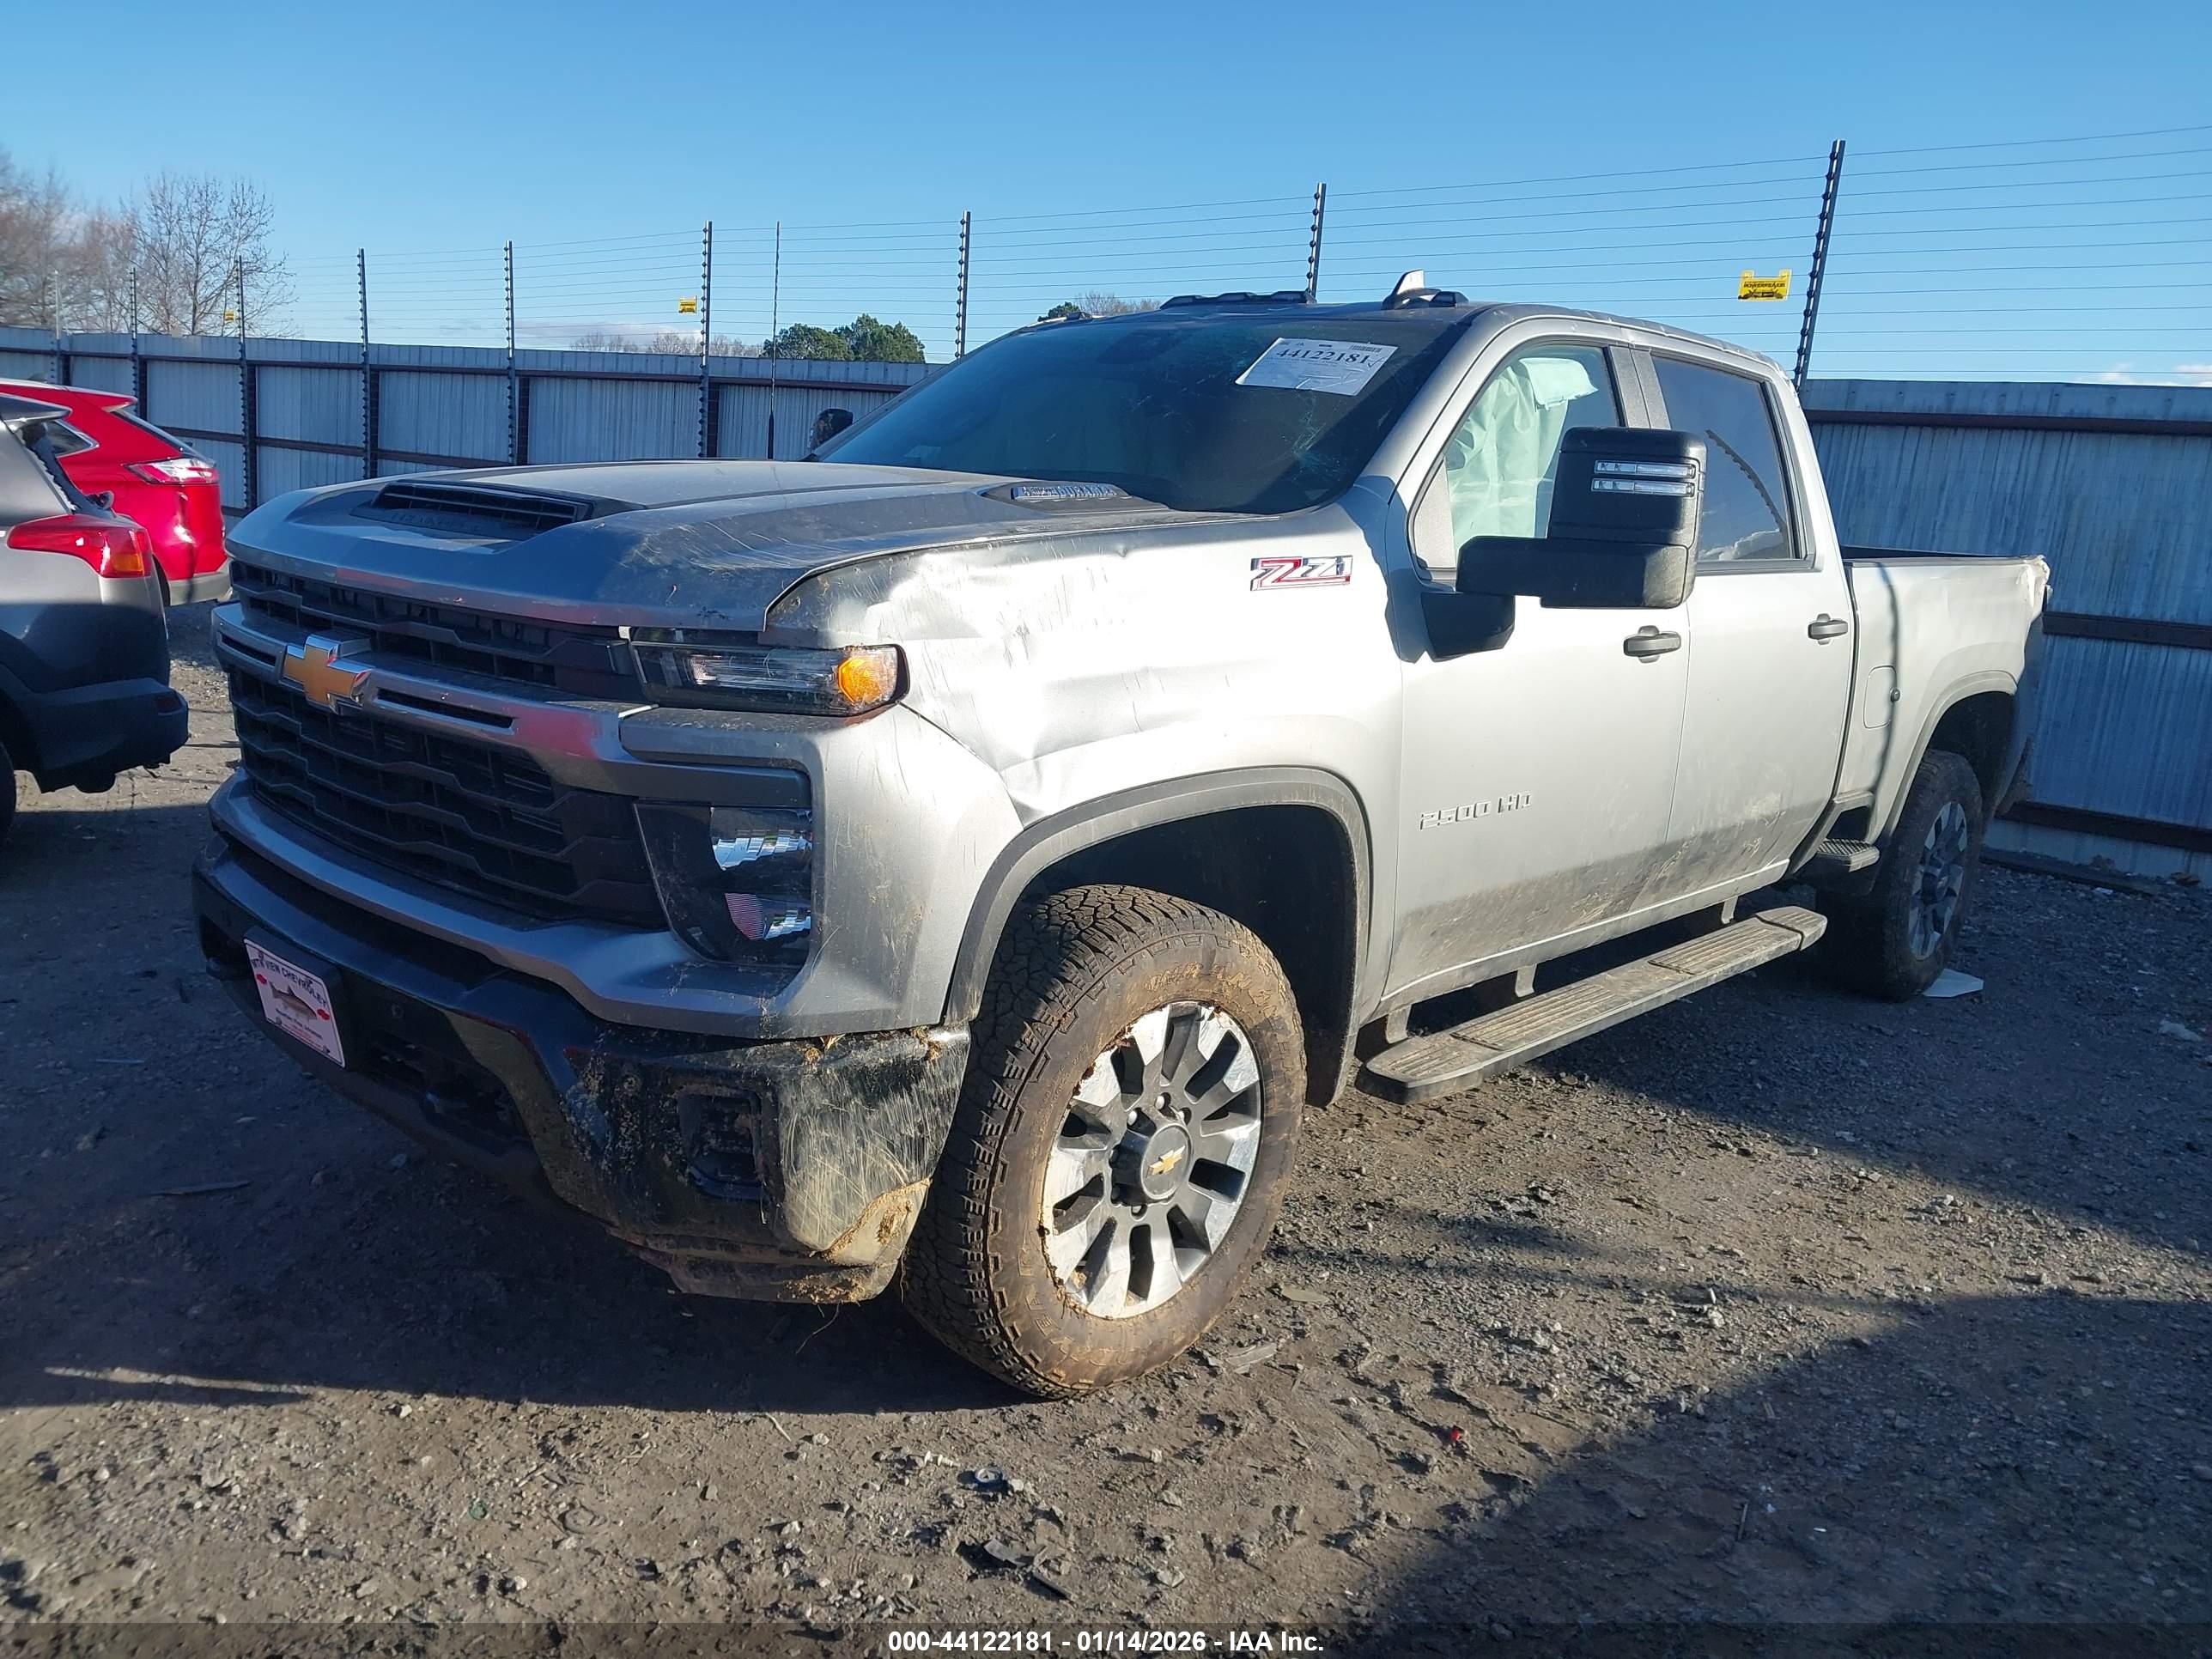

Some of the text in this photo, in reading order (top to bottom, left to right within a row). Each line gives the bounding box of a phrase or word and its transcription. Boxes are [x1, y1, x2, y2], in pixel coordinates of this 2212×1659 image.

[1276, 349, 1370, 364] 44122181
[1250, 555, 1353, 592] Z71
[1419, 791, 1532, 830] 2500 HD
[264, 960, 281, 975] VIEW
[281, 967, 327, 1007] CHEVROLET
